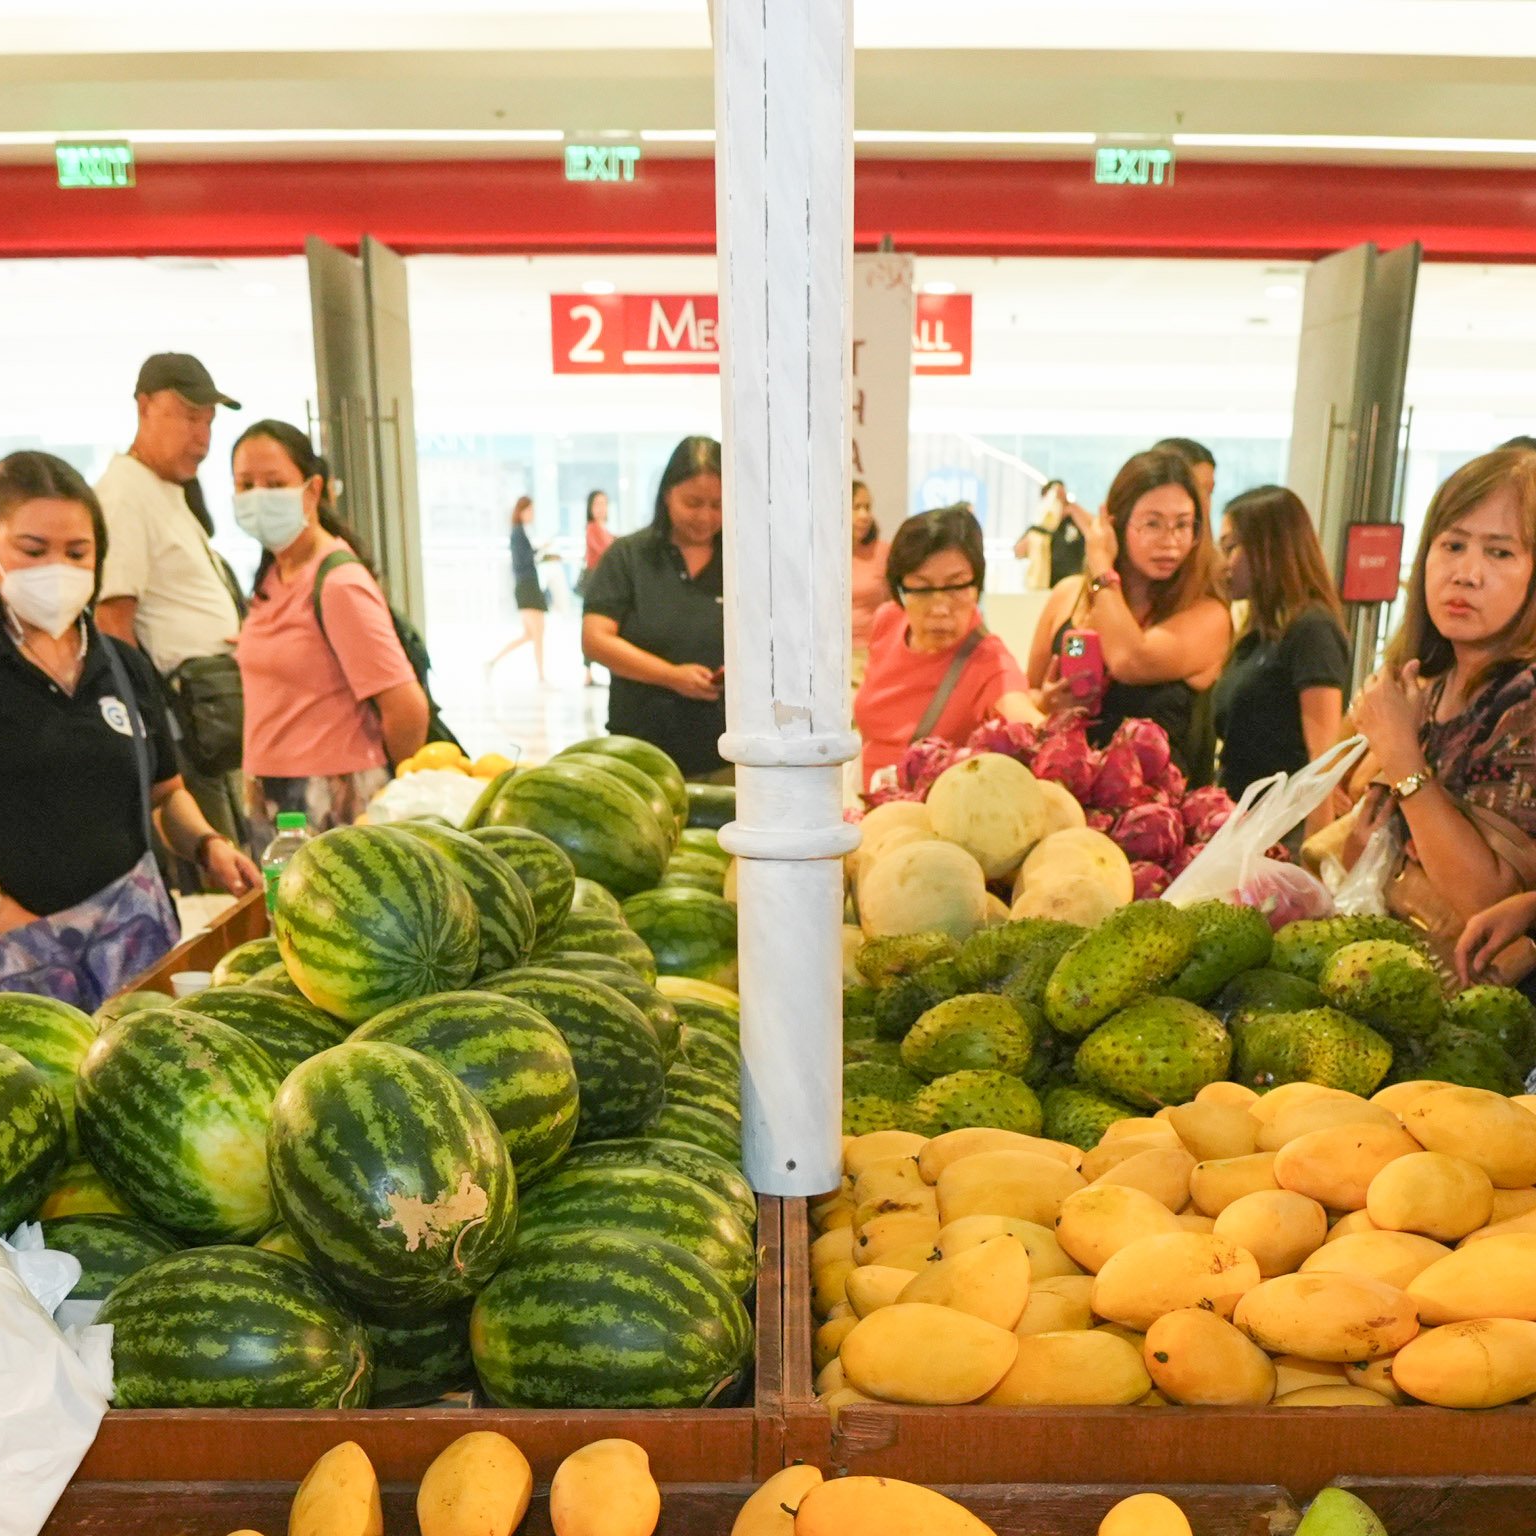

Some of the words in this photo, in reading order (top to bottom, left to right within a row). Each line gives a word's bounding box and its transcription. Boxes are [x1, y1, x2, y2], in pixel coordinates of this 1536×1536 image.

[565, 146, 641, 182] EXIT
[1095, 149, 1170, 185] EXIT
[568, 304, 605, 363] 2
[647, 298, 720, 350] ME
